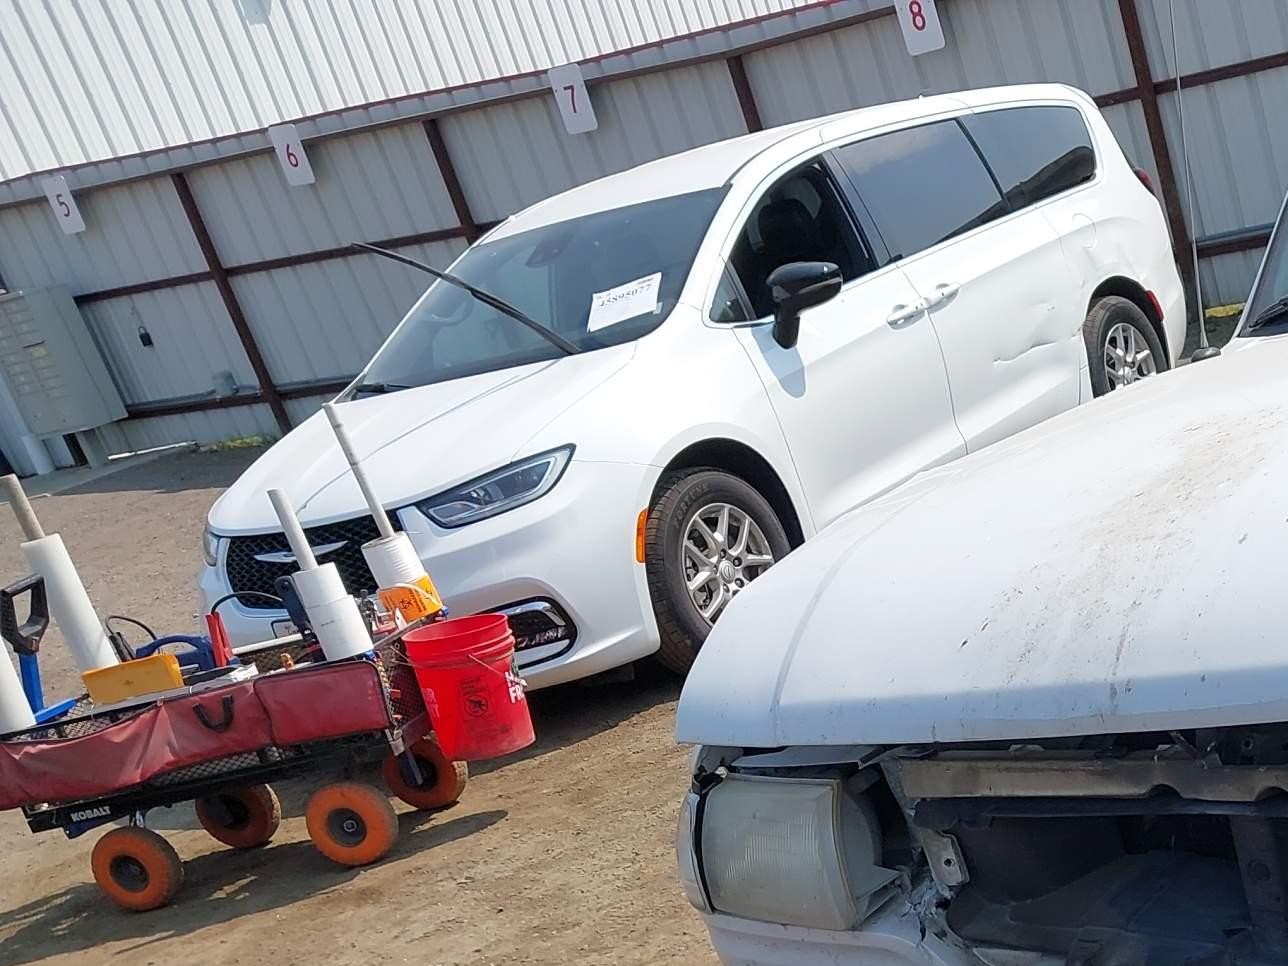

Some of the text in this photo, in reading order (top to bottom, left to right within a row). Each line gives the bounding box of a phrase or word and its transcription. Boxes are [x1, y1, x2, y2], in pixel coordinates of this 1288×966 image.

[909, 0, 926, 31] 8
[563, 85, 577, 114] 7
[286, 143, 299, 168] 6
[56, 193, 70, 217] 5
[70, 806, 111, 822] KOBALT
